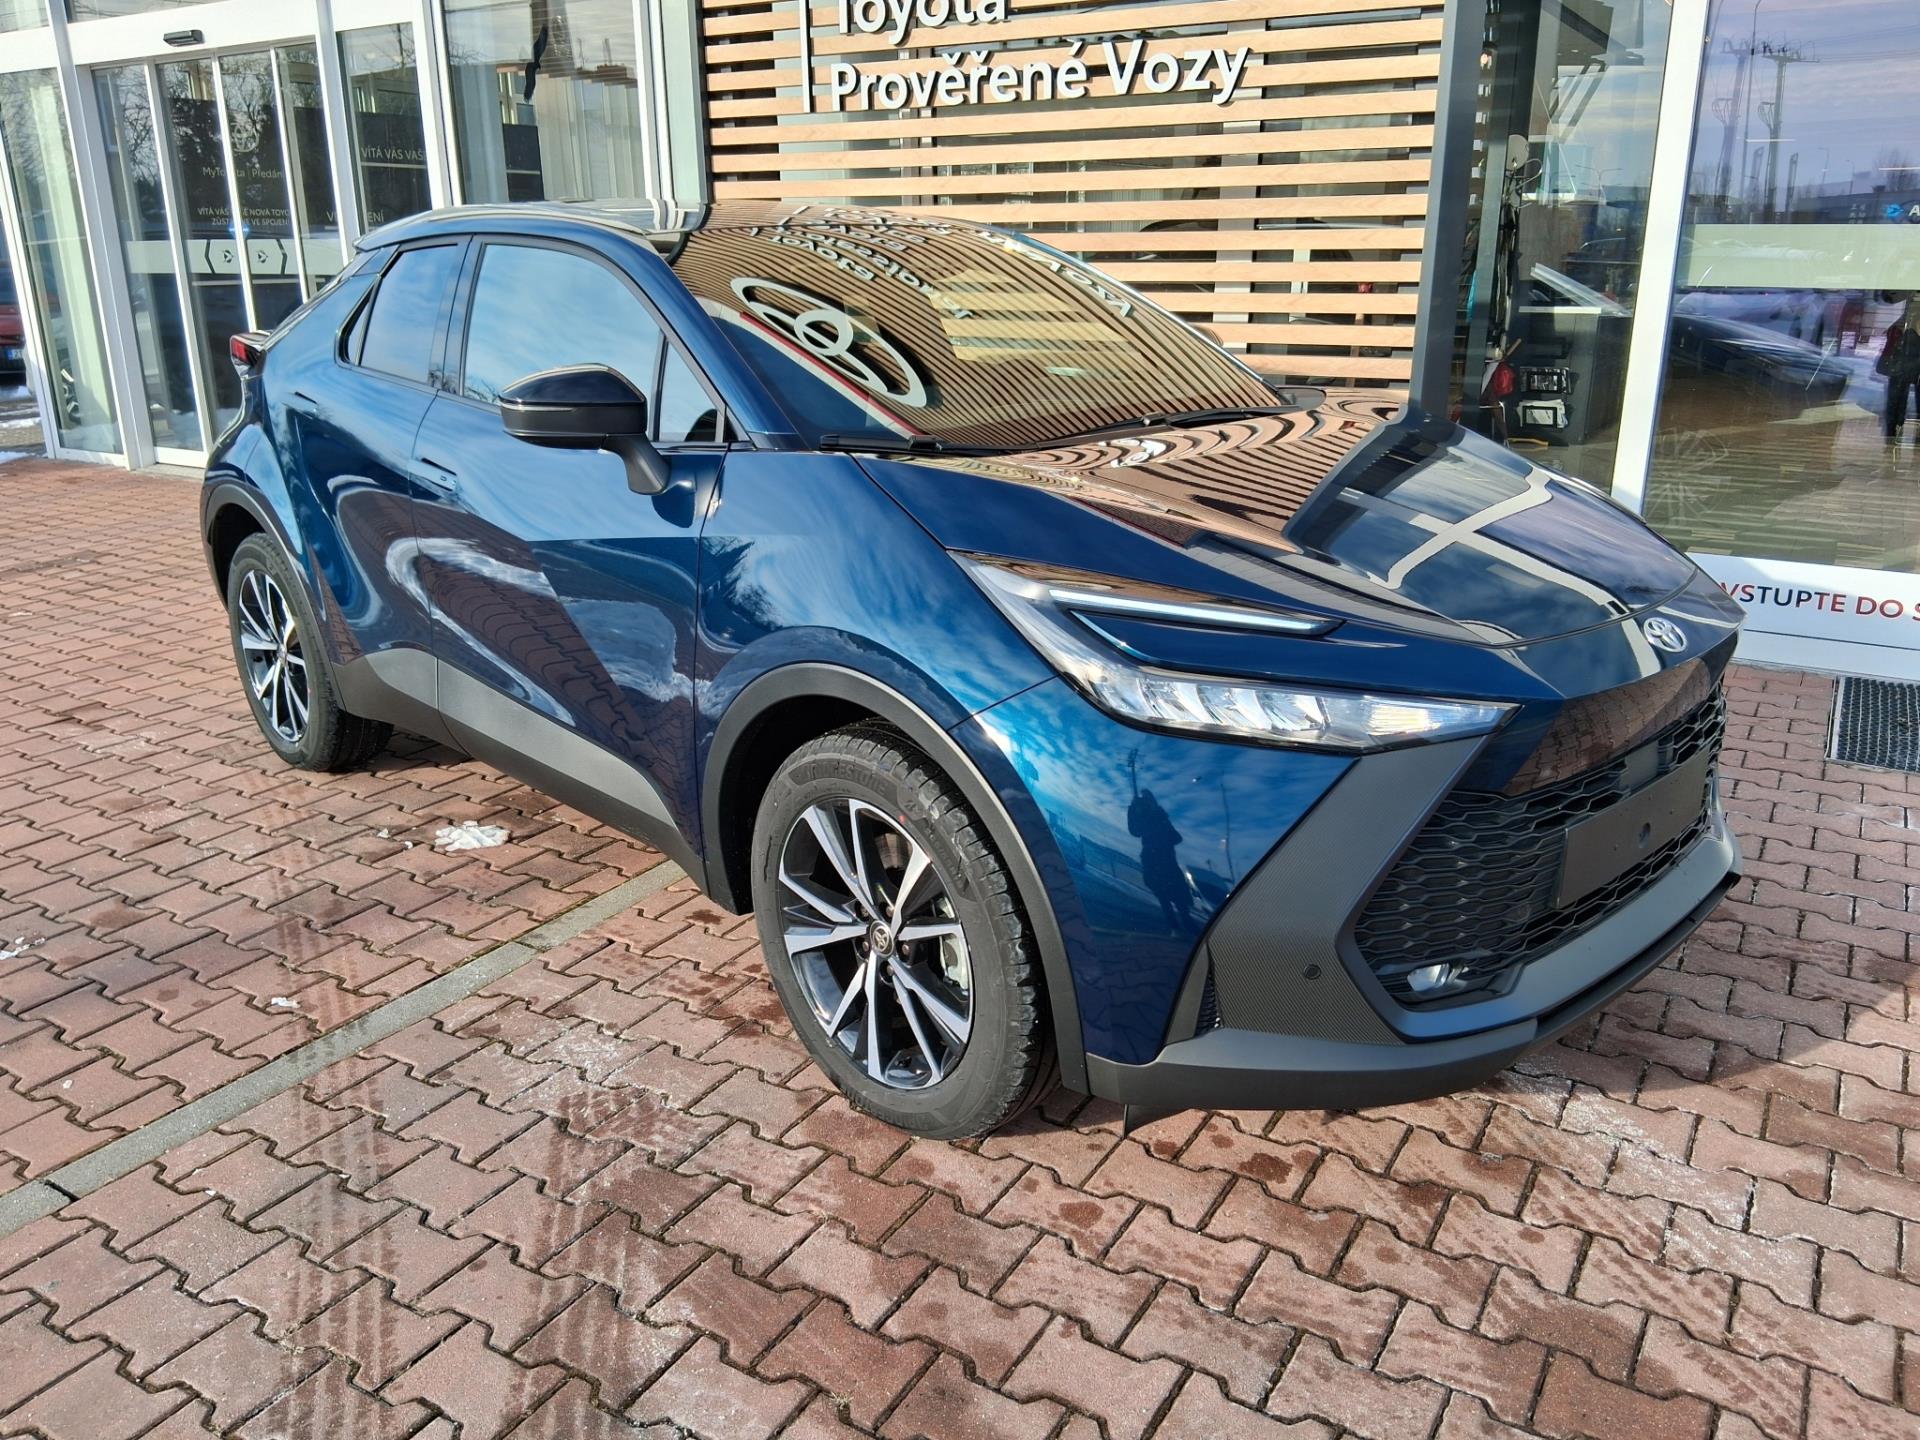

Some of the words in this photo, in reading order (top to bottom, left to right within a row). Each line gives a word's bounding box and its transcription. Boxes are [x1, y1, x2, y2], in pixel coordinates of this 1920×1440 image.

[831, 41, 1089, 112] Prověřené
[1102, 38, 1250, 106] Vozy
[1720, 582, 1847, 613] VSTUPTE
[1855, 596, 1904, 618] DO
